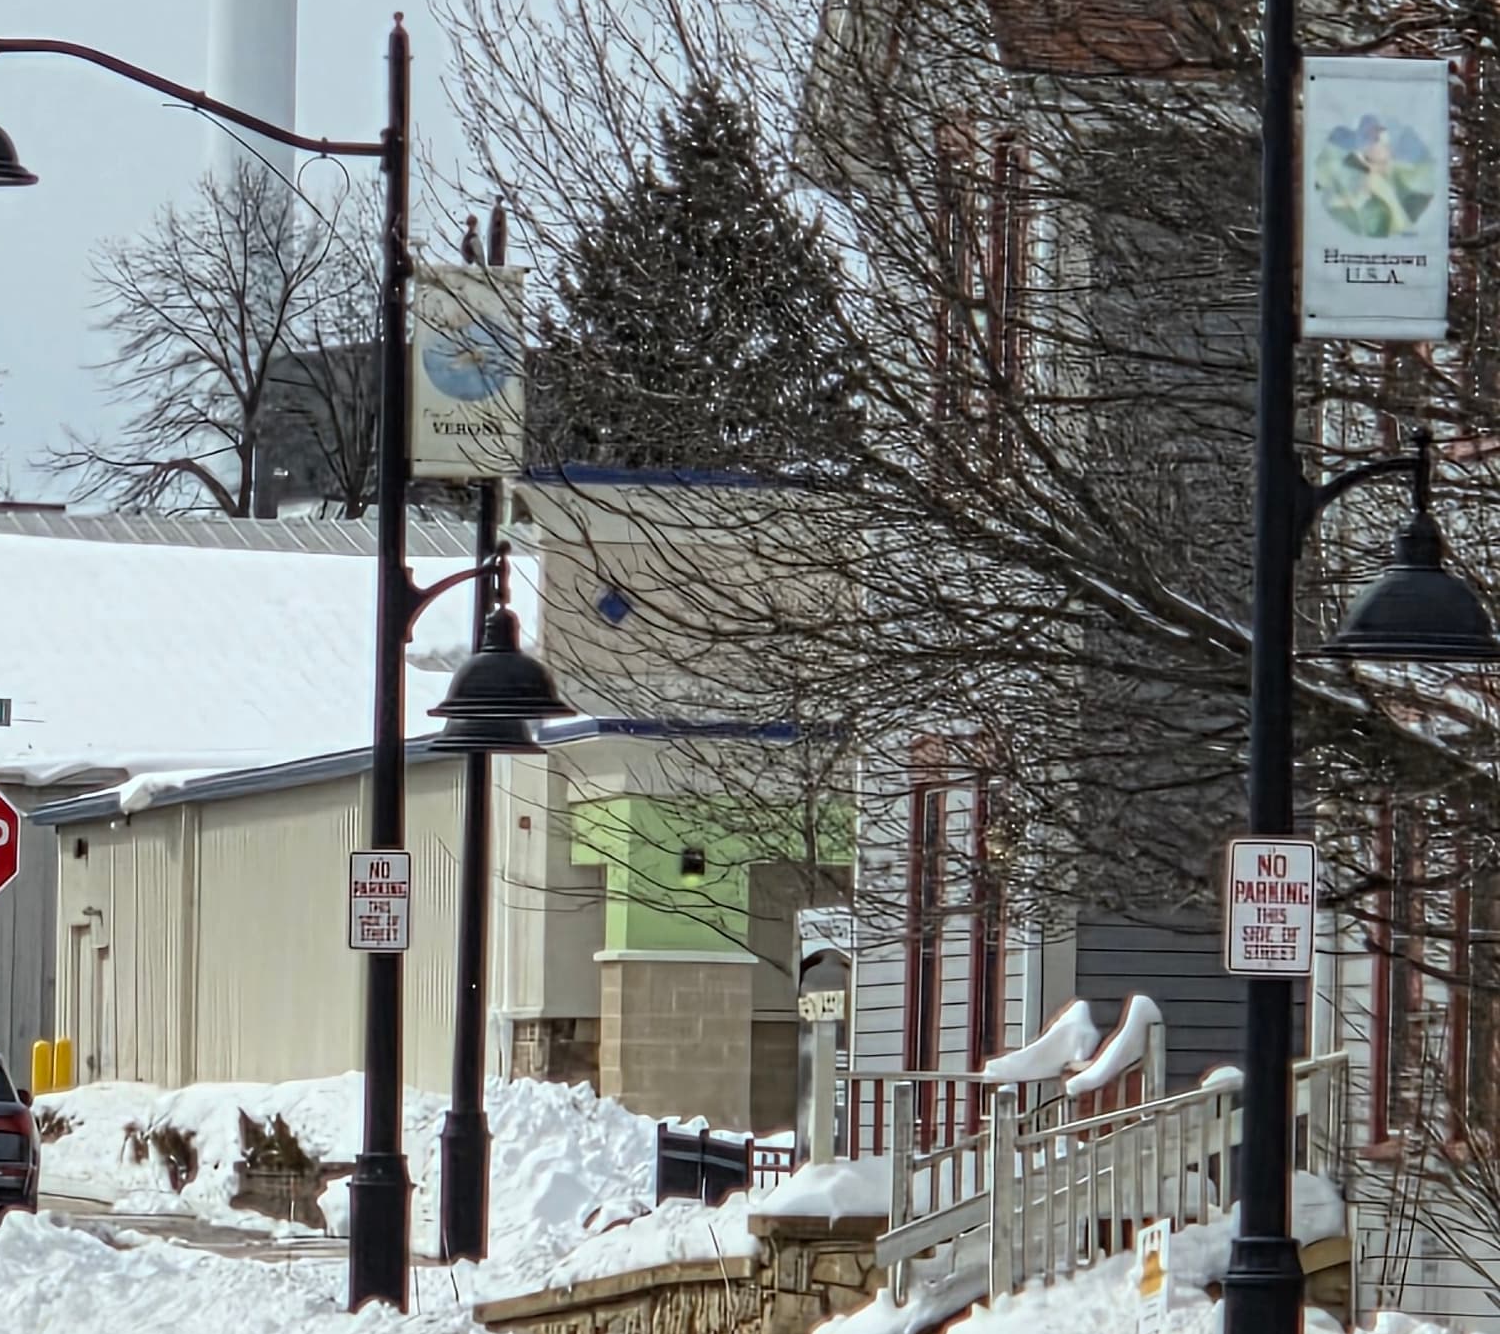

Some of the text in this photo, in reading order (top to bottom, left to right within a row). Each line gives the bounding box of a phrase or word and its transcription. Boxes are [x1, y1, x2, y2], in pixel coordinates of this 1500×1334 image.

[369, 860, 391, 880] NO
[1257, 854, 1288, 879] NO
[1234, 880, 1310, 905] PARKING
[1256, 907, 1287, 924] THIS
